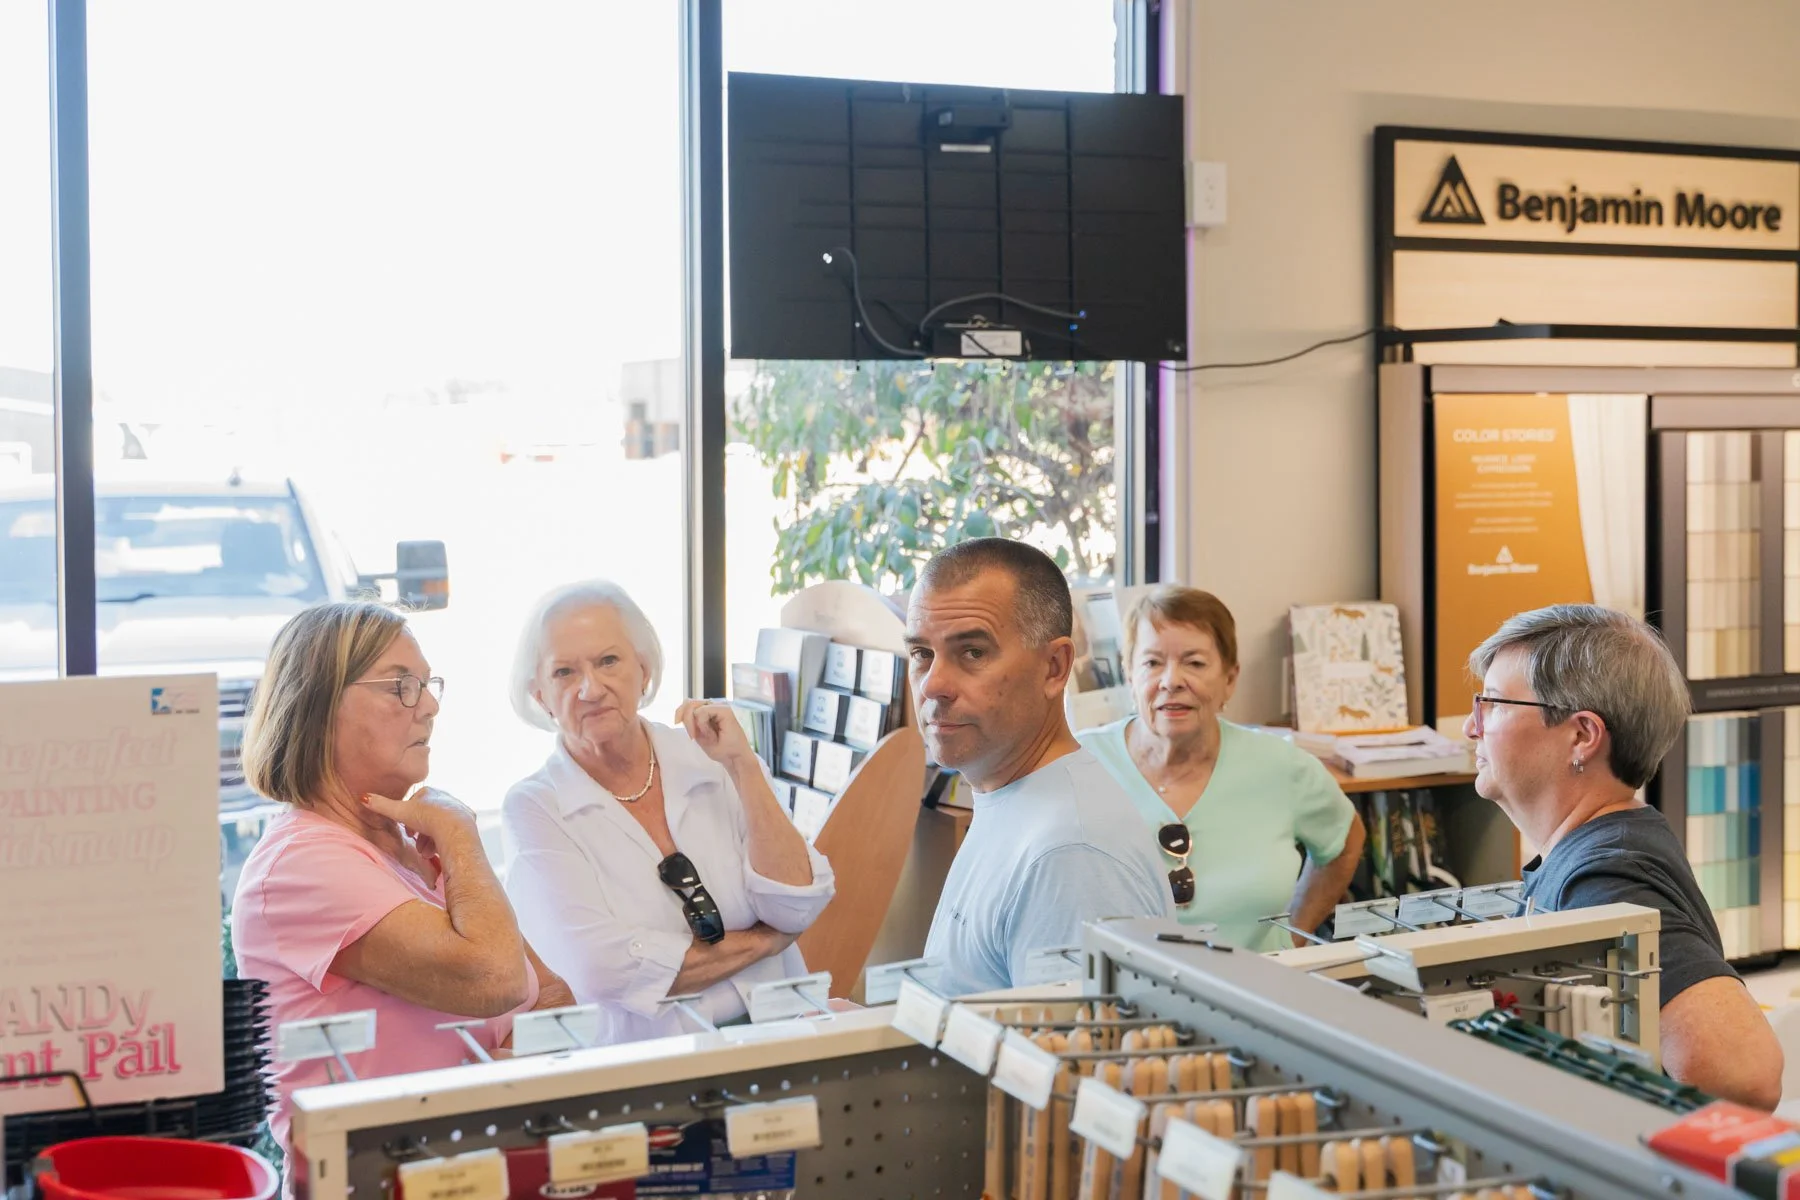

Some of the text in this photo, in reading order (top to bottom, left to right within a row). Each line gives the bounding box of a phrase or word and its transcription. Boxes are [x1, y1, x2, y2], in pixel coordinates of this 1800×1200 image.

[1497, 182, 1783, 234] Benjamin Moore
[1453, 428, 1500, 443] COLOR
[80, 1022, 183, 1082] Pail
